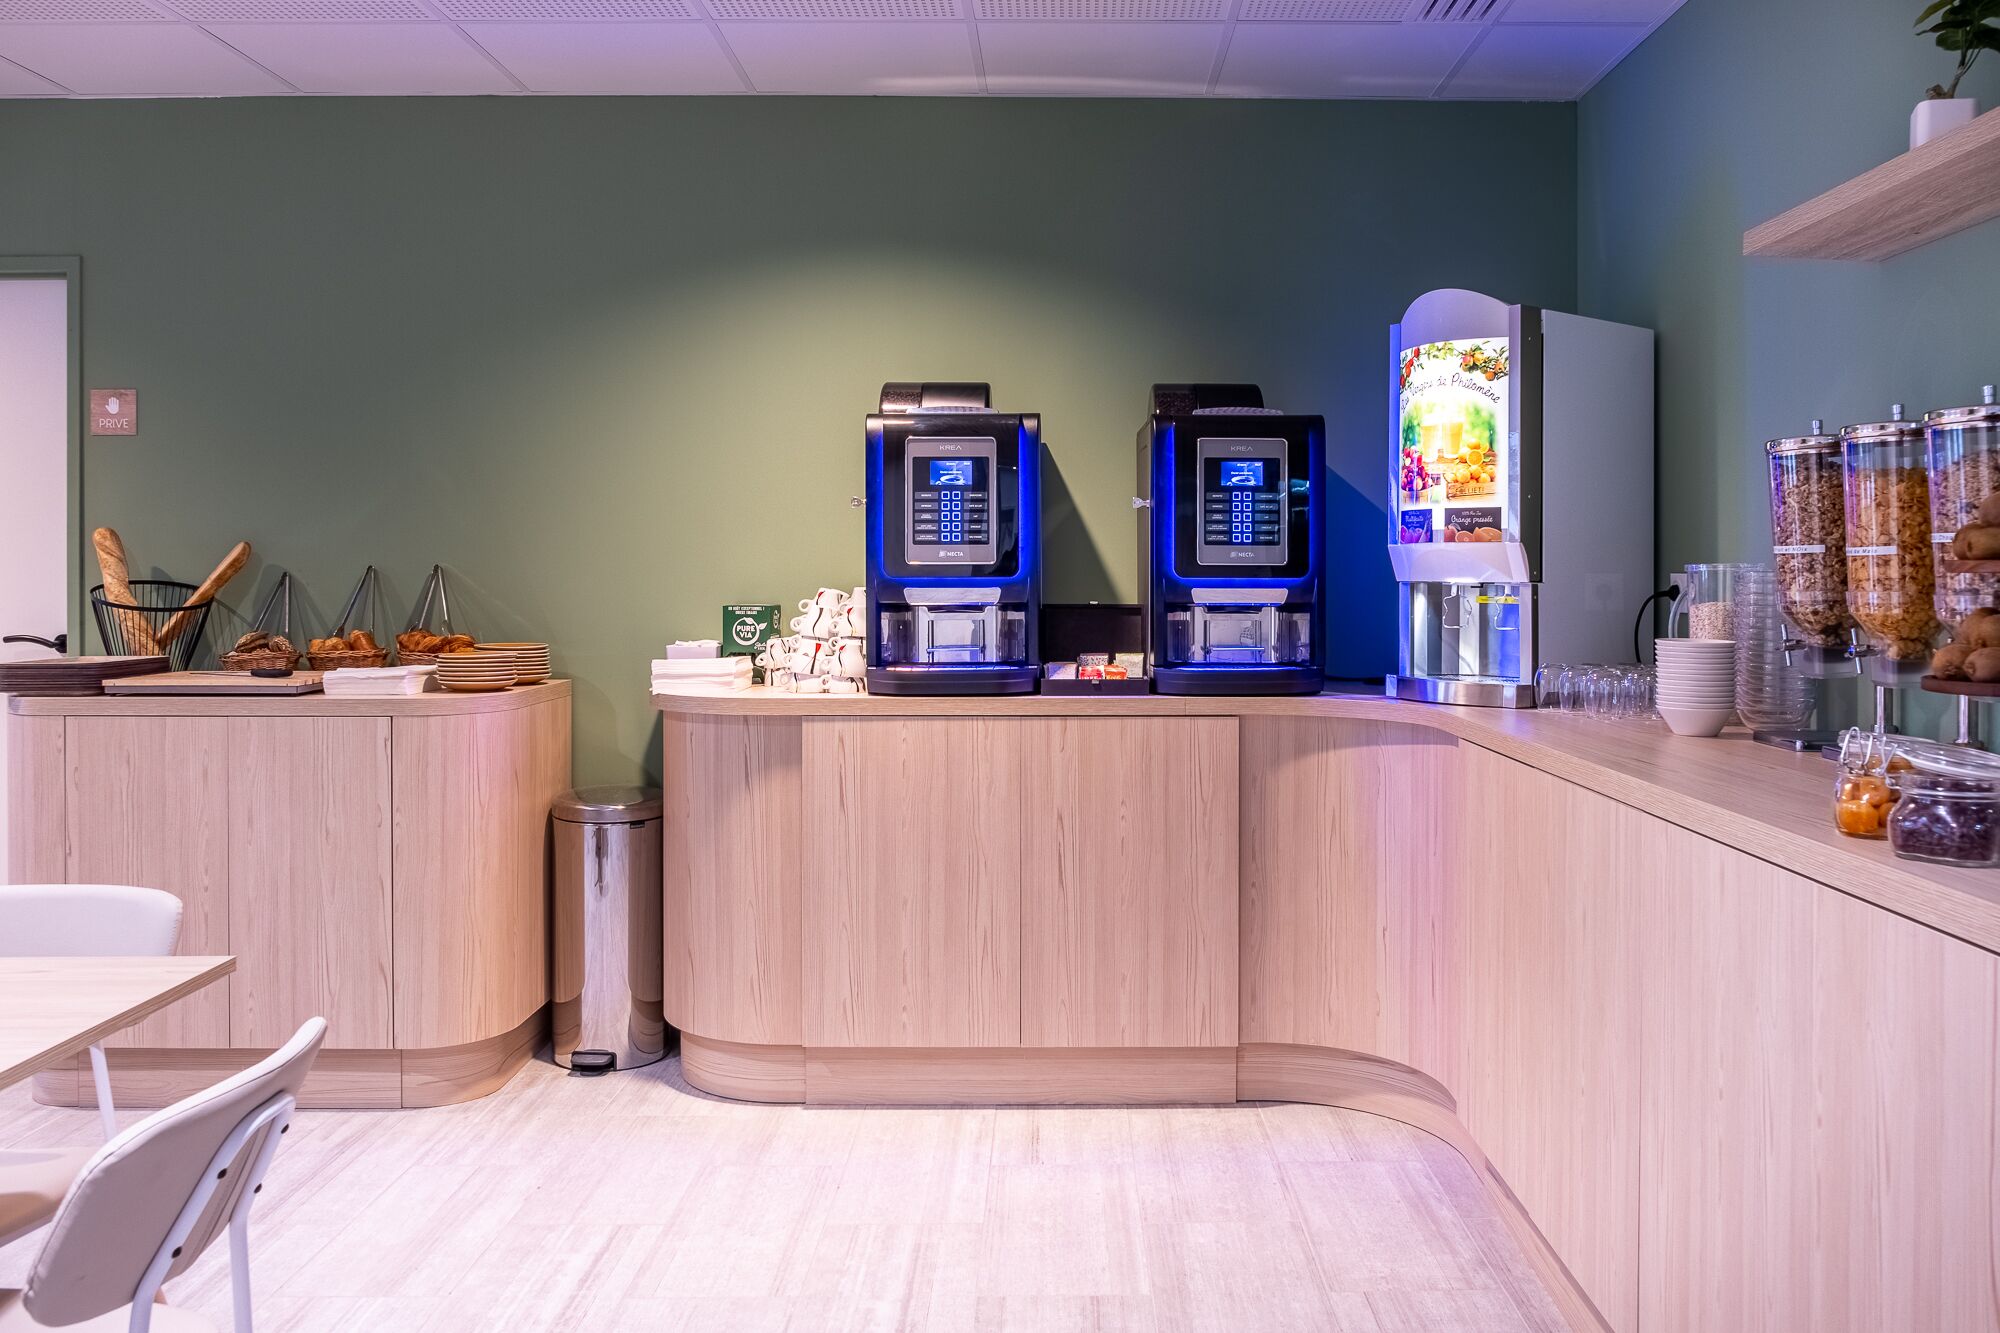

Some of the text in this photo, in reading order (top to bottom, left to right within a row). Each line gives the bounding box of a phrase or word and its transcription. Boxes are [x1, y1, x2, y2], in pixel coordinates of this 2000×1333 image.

[1437, 375, 1446, 386] de
[1451, 372, 1500, 403] Philomène
[99, 418, 129, 428] PRIVE
[1451, 514, 1472, 525] Orange
